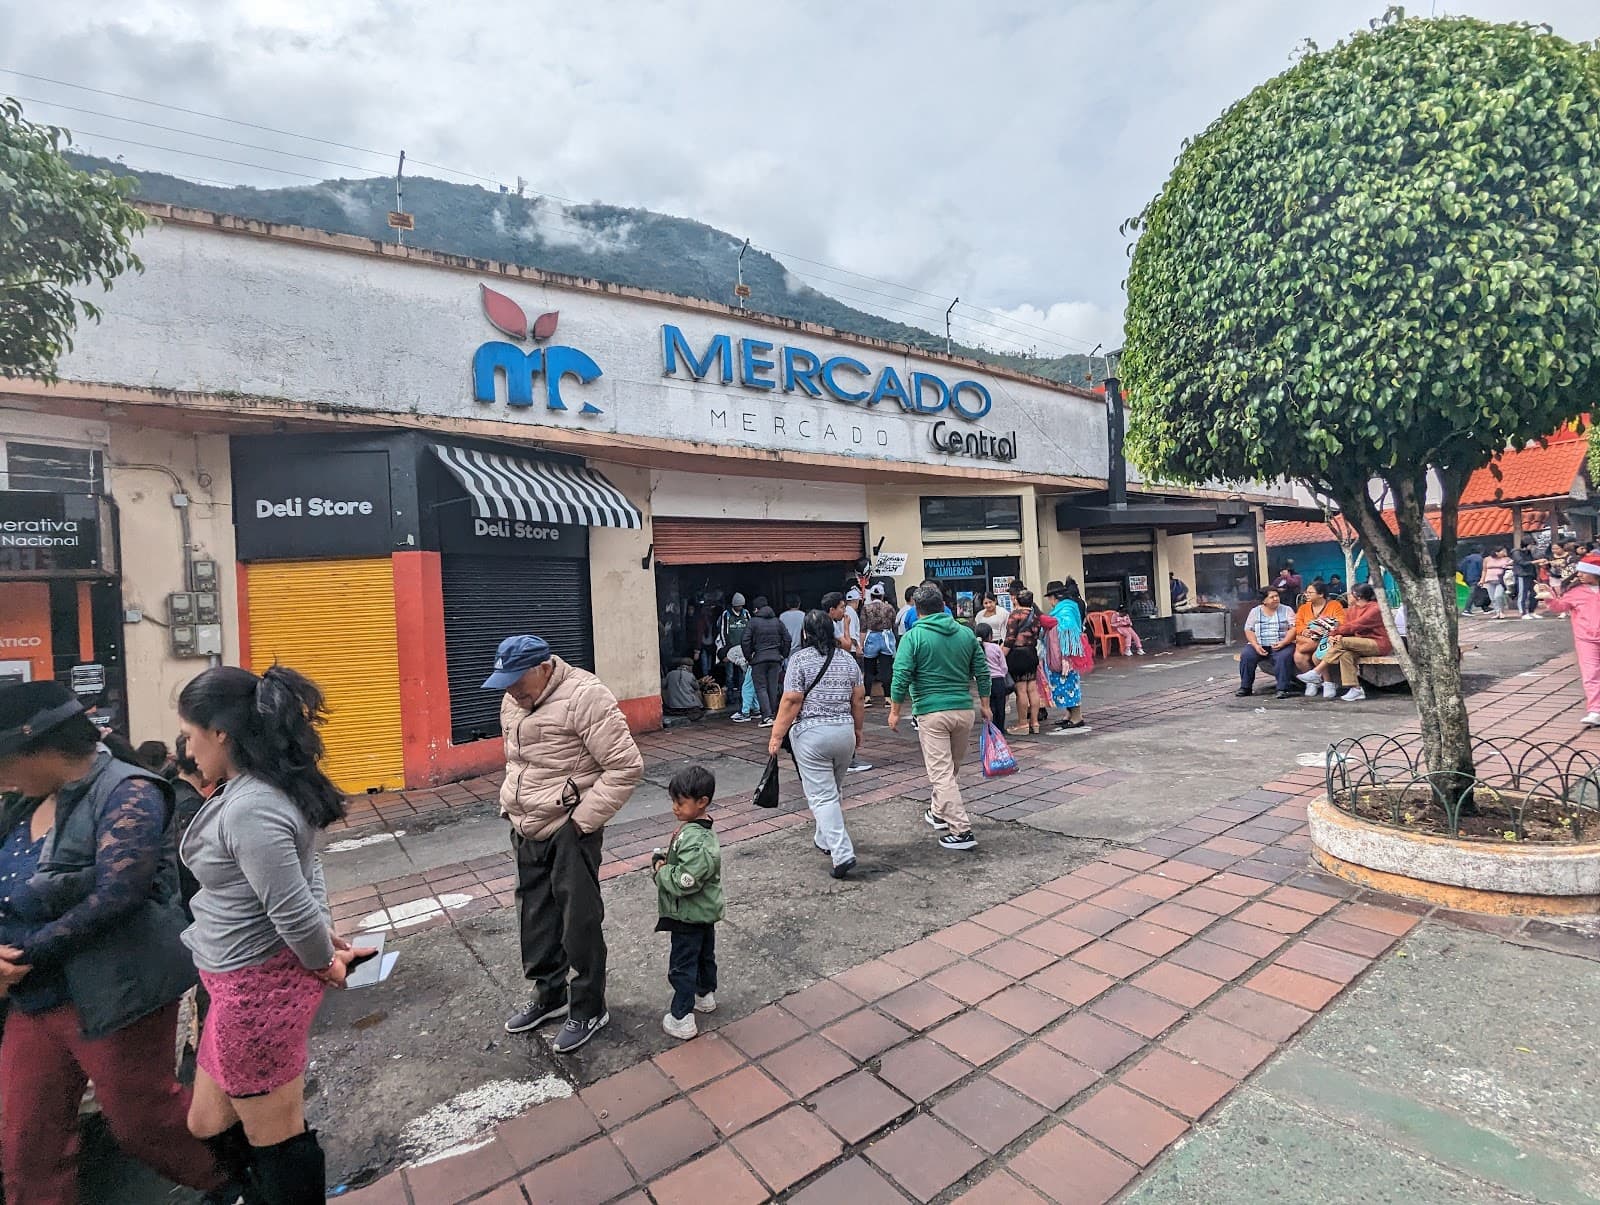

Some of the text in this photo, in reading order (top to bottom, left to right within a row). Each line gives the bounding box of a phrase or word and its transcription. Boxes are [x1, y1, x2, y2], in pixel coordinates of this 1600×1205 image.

[661, 323, 992, 420] MERCADO
[710, 409, 888, 446] MERCADO
[929, 420, 1018, 461] Central
[256, 497, 373, 518] Deli Store
[0, 518, 78, 532] erativa
[474, 519, 560, 540] Deli Store
[2, 535, 79, 546] Nacional
[935, 567, 974, 577] ALMUERZOS
